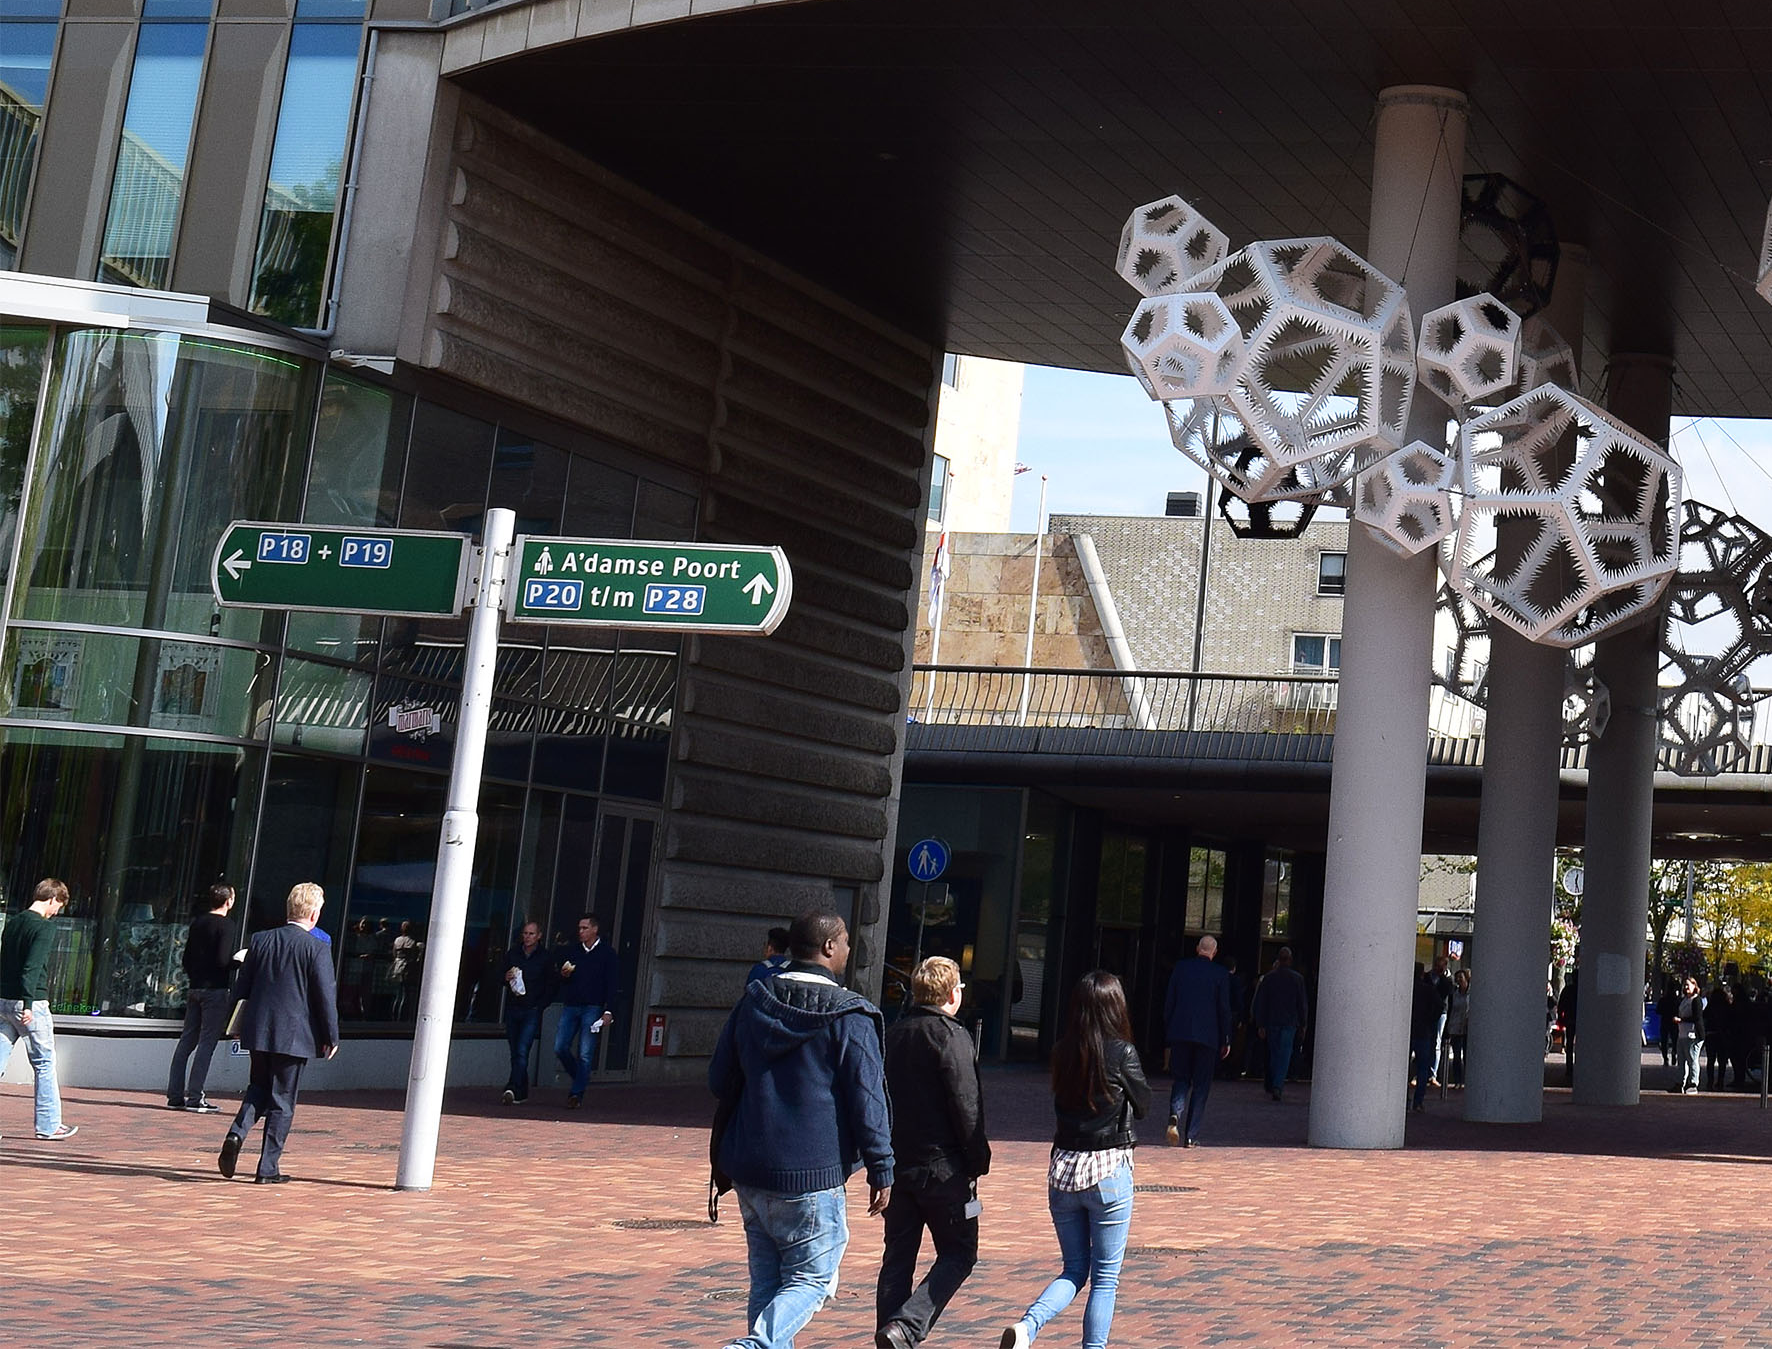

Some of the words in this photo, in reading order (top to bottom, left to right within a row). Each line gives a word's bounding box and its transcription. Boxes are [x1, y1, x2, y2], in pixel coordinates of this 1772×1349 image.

[262, 538, 304, 559] P18
[317, 544, 332, 560] +
[344, 542, 387, 564] P19
[560, 552, 664, 576] A'damse
[672, 556, 741, 579] Poort
[528, 584, 576, 605] P20
[590, 585, 634, 608] t/m
[648, 589, 699, 610] P28
